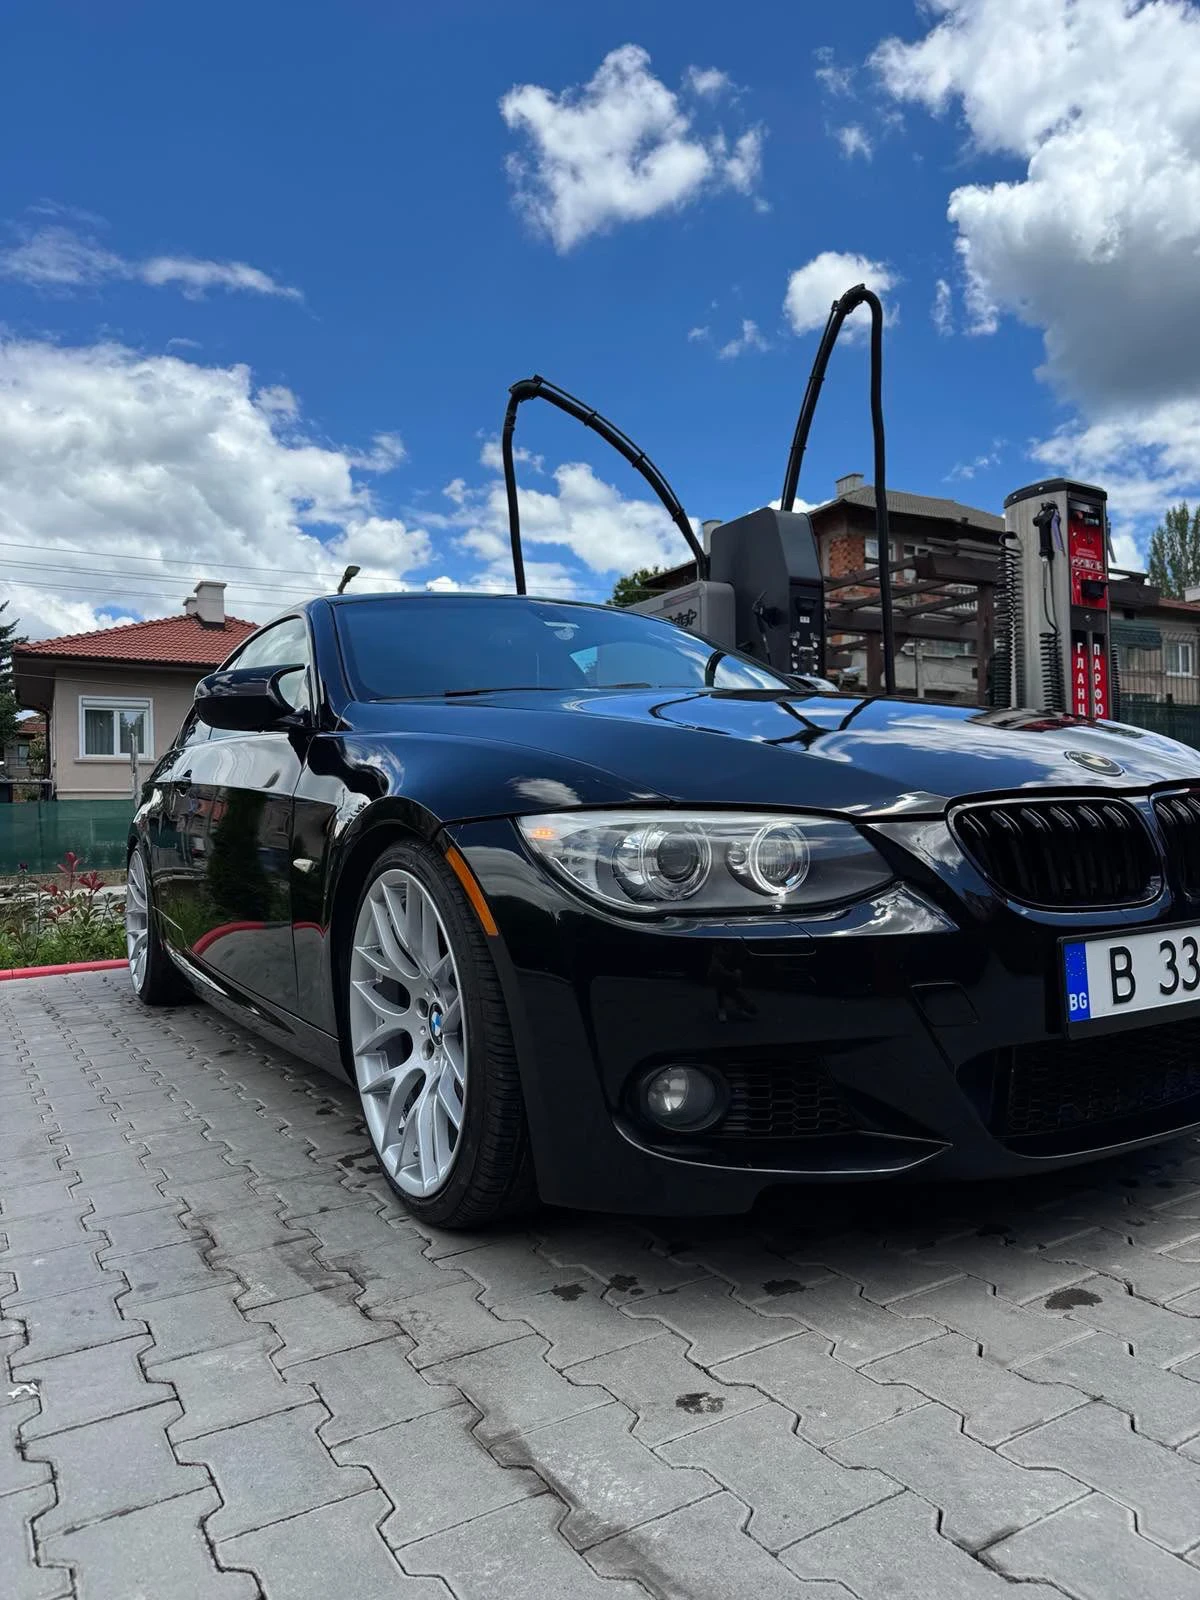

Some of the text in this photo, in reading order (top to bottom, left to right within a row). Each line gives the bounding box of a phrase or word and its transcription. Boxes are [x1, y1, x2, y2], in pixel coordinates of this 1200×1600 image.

[1076, 642, 1086, 717] ГЛАНЦ
[1069, 992, 1088, 1011] BG
[1109, 936, 1200, 1005] B 33
